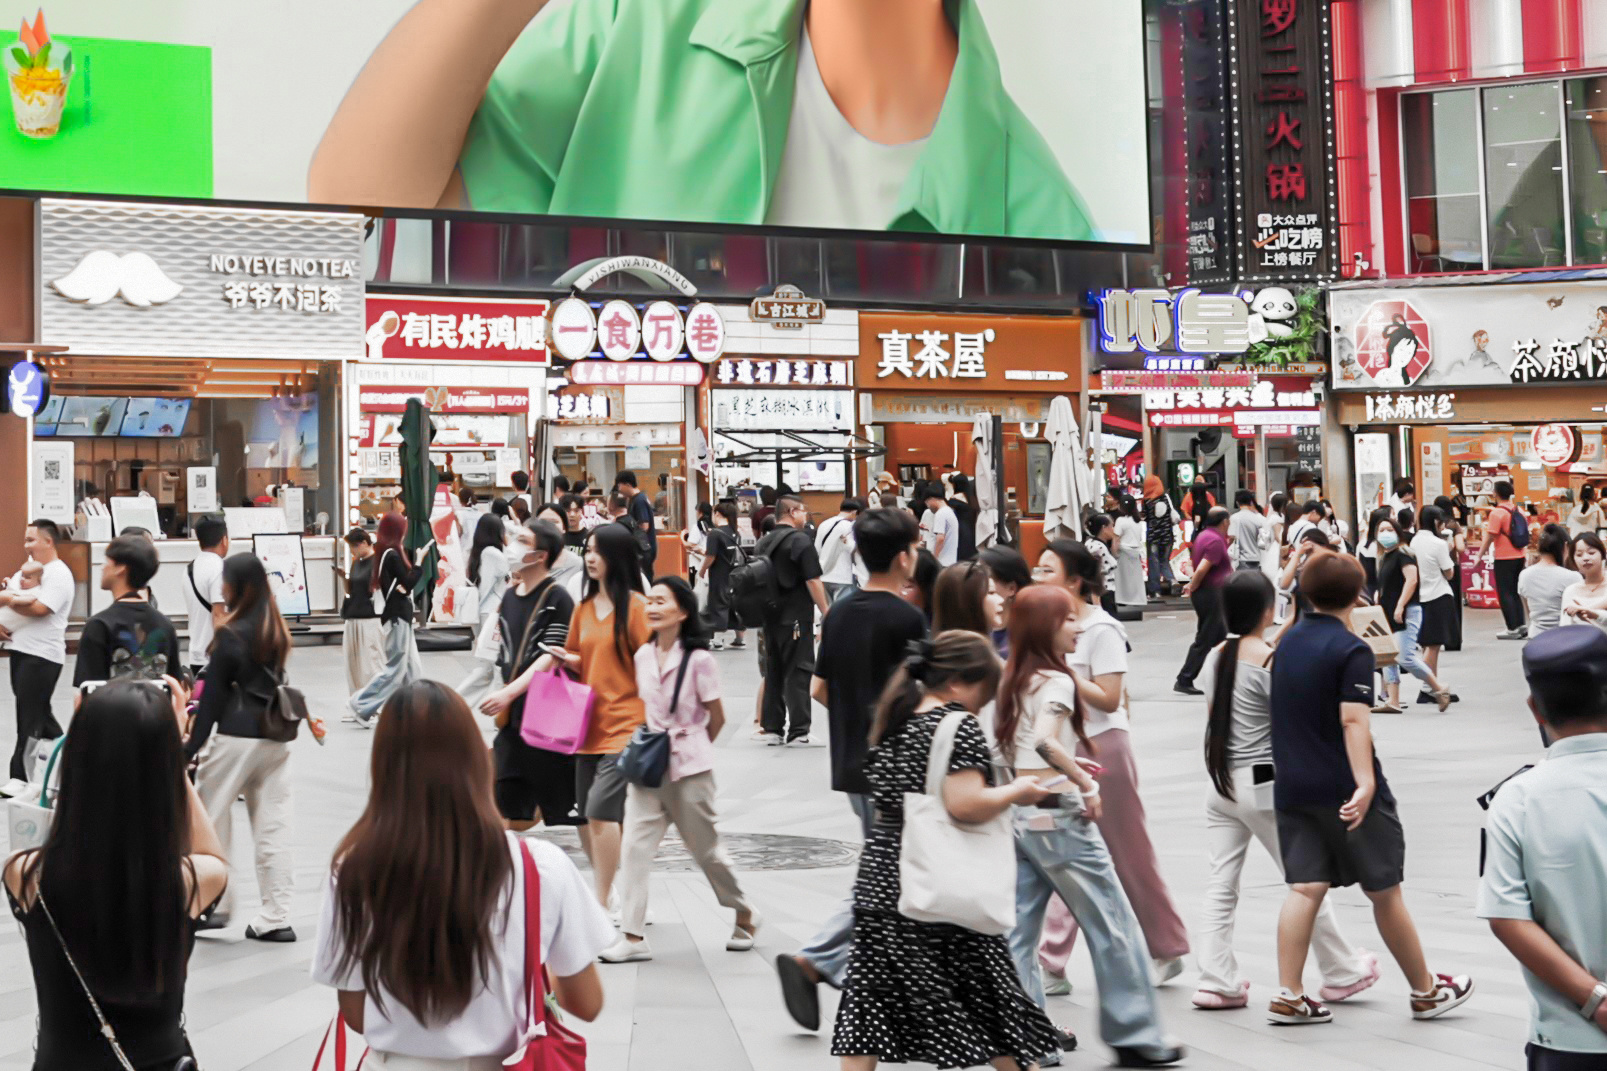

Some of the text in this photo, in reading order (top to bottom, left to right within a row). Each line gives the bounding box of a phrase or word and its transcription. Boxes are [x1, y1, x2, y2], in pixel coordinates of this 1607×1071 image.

[1273, 214, 1317, 225] 大众点评
[1254, 227, 1323, 250] 必吃榜
[210, 254, 353, 277] NO YEYE NO TEA
[1260, 252, 1317, 266] 上榜餐厅
[589, 258, 689, 291] YISHIWANXIANG
[224, 281, 342, 312] 爷爷不泡茶
[399, 312, 547, 351] 有民炸鸡腿
[559, 311, 719, 352] 一食万巷
[877, 329, 987, 379] 真茶屋
[1375, 394, 1455, 421] 茶颜悦色
